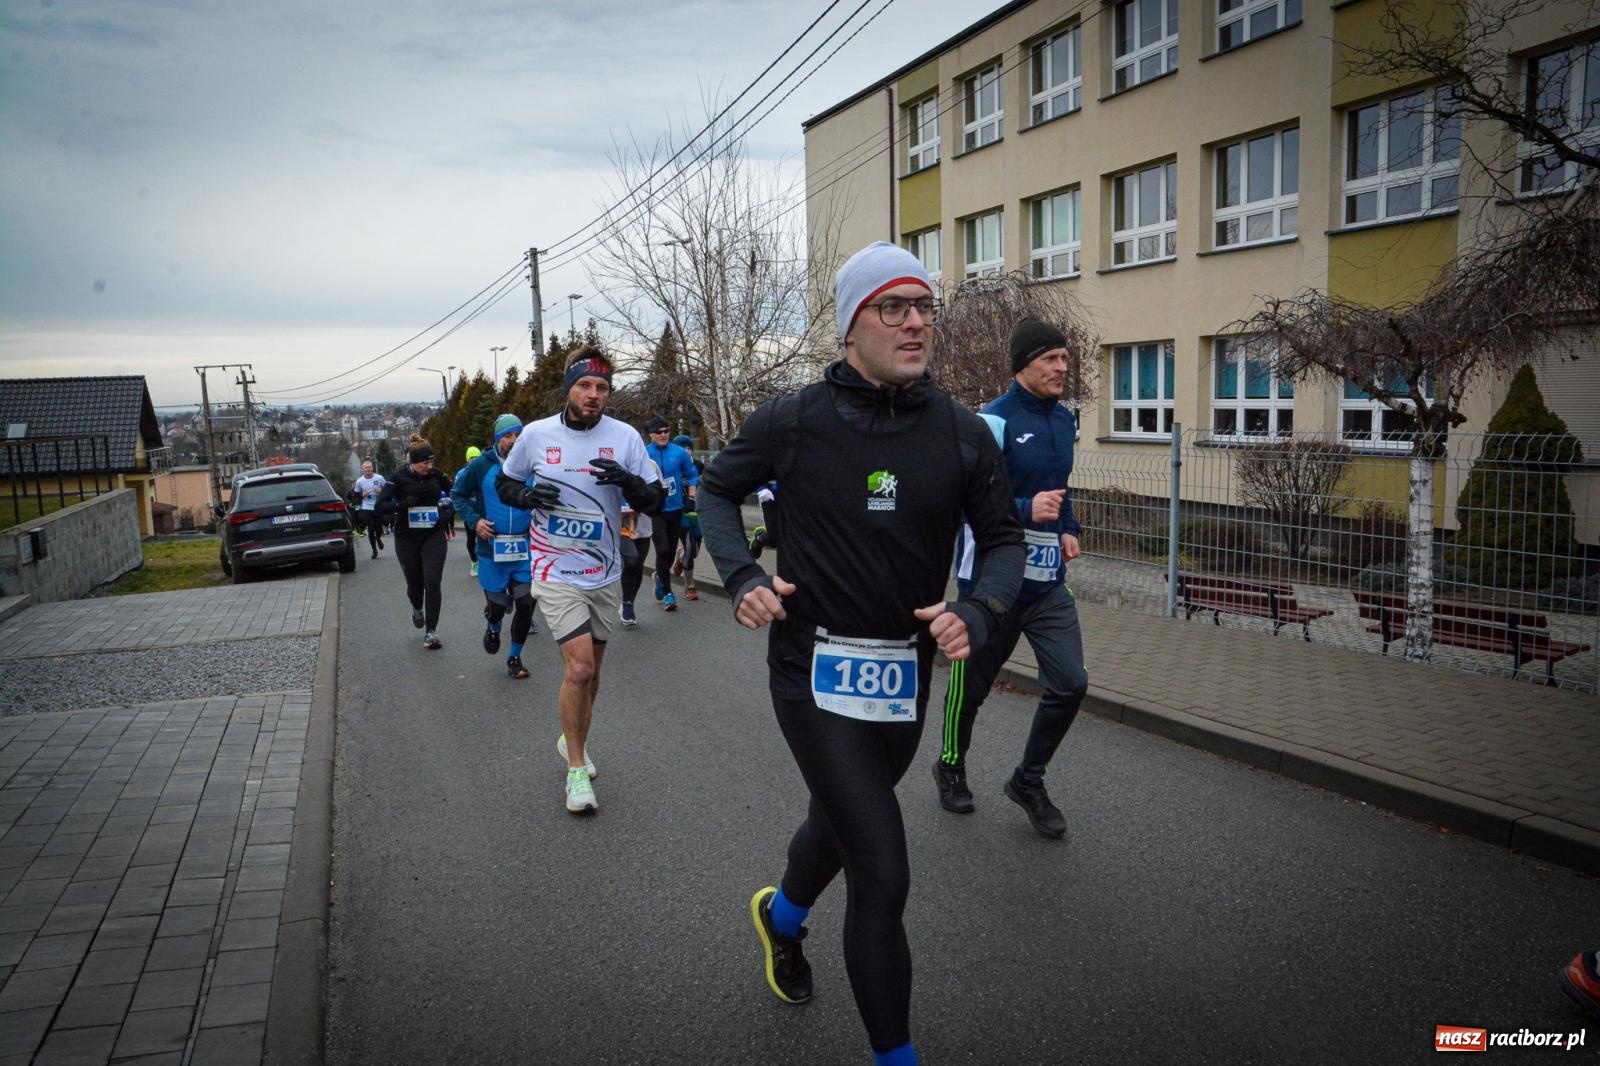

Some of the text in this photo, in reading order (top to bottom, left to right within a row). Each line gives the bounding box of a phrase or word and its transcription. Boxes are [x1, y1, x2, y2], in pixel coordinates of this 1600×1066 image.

[417, 512, 430, 522] 11
[554, 518, 595, 538] 209
[504, 542, 519, 554] 21
[1026, 544, 1056, 567] 210
[834, 659, 903, 696] 180
